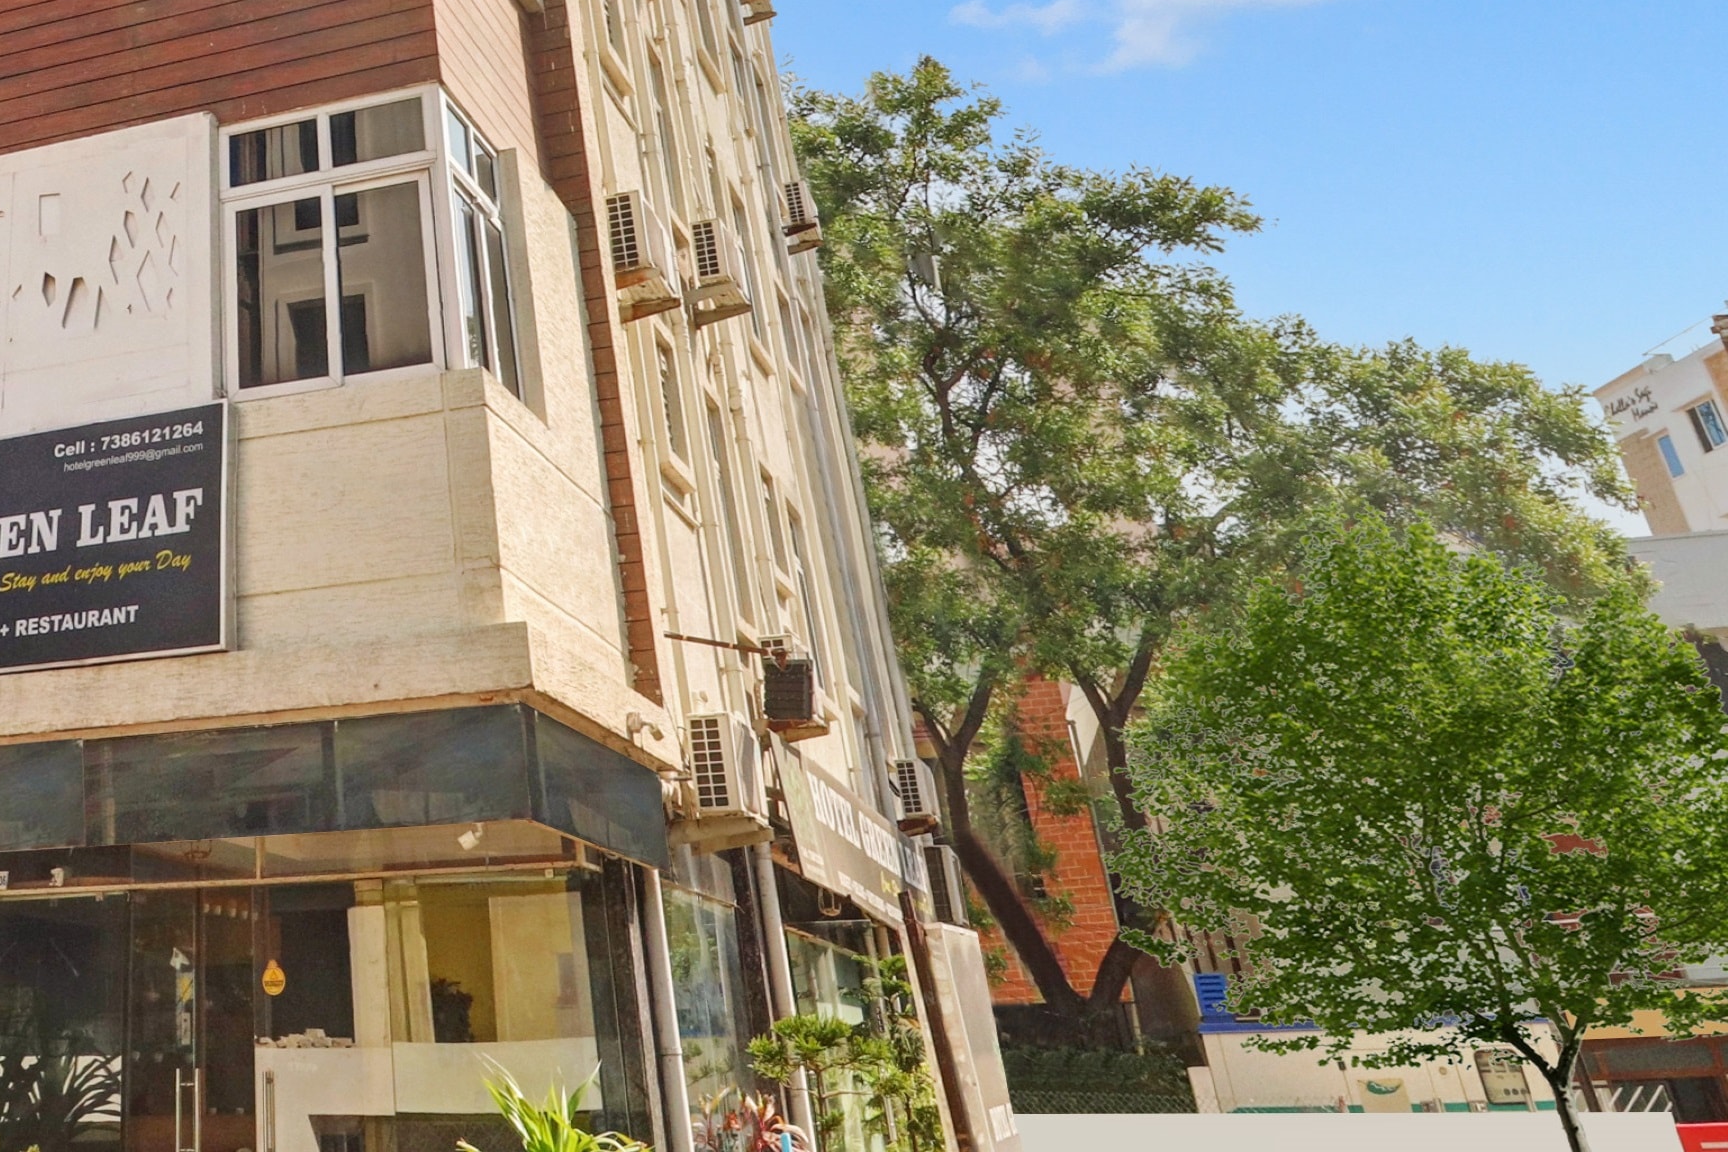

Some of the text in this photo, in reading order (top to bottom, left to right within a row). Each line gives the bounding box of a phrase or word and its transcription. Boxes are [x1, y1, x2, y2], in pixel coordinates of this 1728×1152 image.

[54, 441, 85, 458] Cell
[100, 421, 204, 451] 7386121264
[63, 442, 204, 473] hotelgreenleaf999@gmail.com
[76, 488, 204, 548] LEAF
[41, 565, 71, 585] and
[74, 562, 114, 584] enjoy
[118, 558, 152, 579] your
[155, 549, 193, 572] Day
[14, 605, 139, 637] RESTAURANT
[805, 770, 862, 850] HOTEL
[858, 810, 903, 879] GREEN
